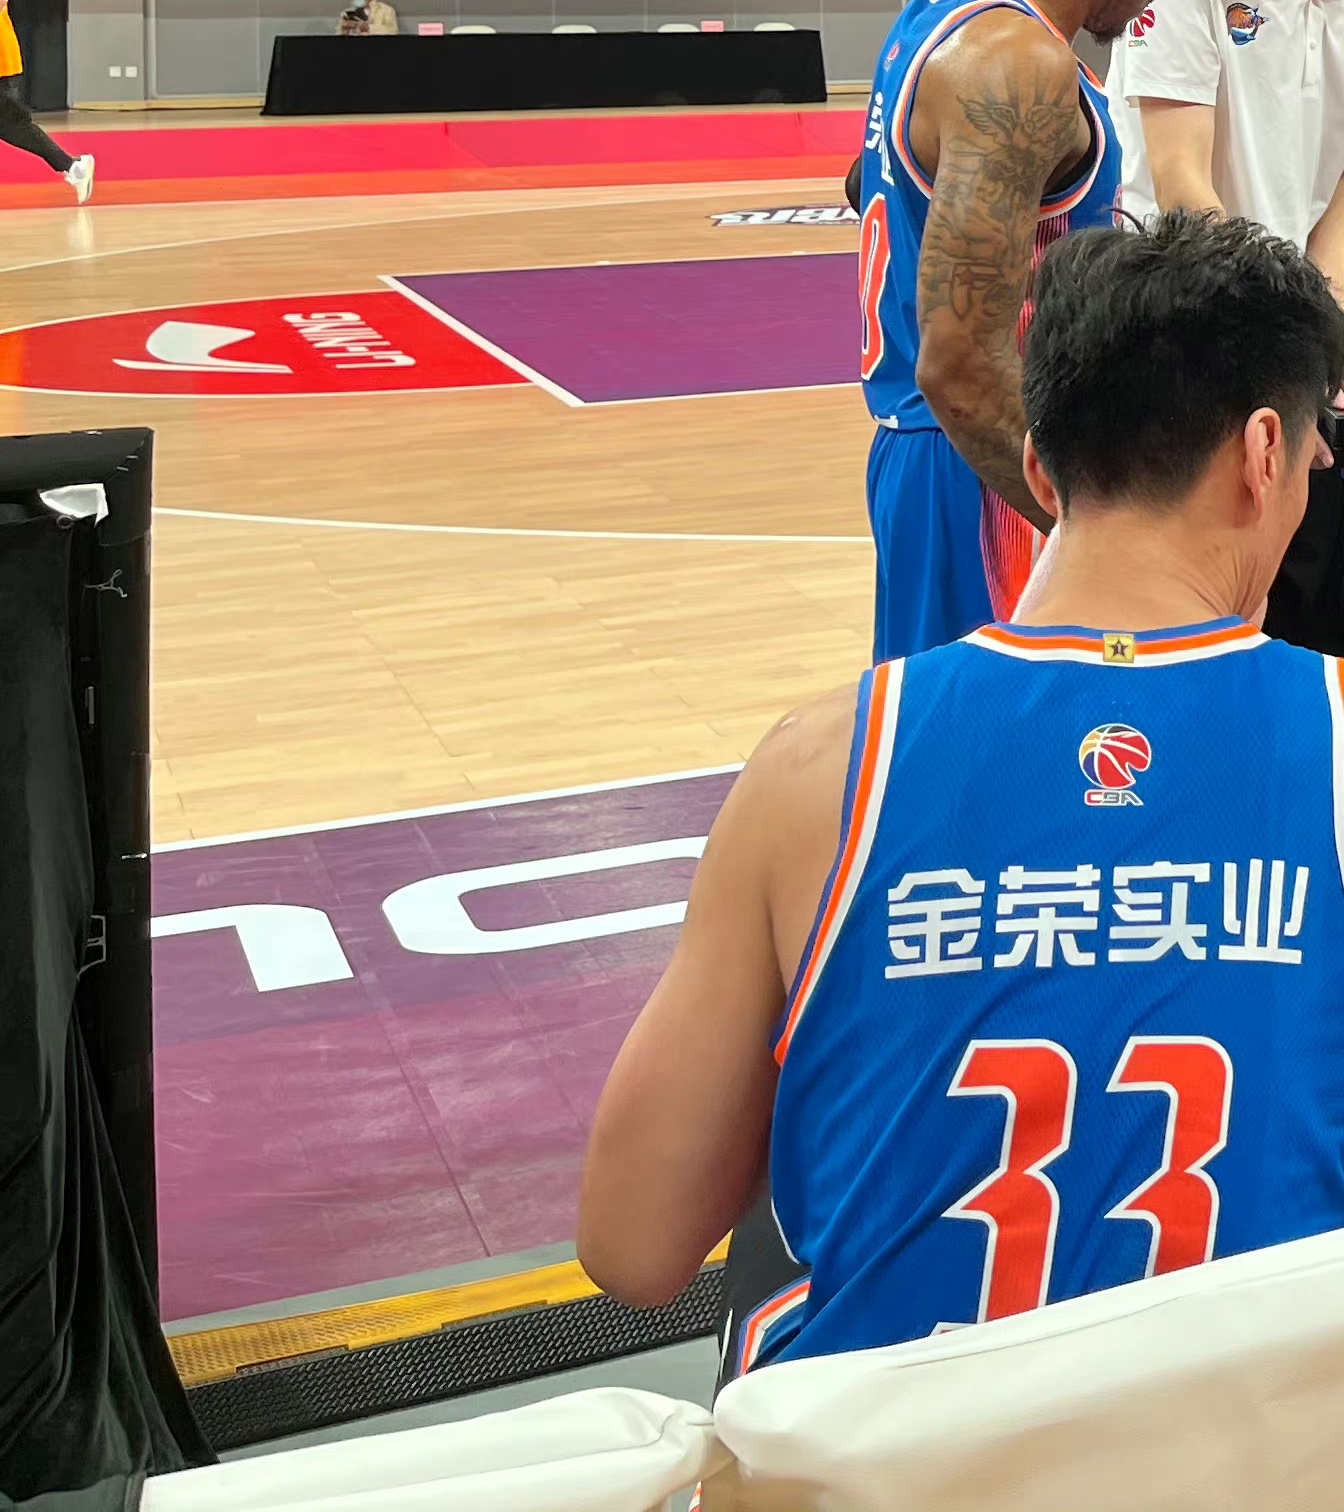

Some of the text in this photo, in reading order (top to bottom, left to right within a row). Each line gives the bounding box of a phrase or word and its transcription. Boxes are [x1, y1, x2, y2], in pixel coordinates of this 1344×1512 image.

[883, 858, 1311, 980] 金荣实业
[931, 1034, 1235, 1334] 33
